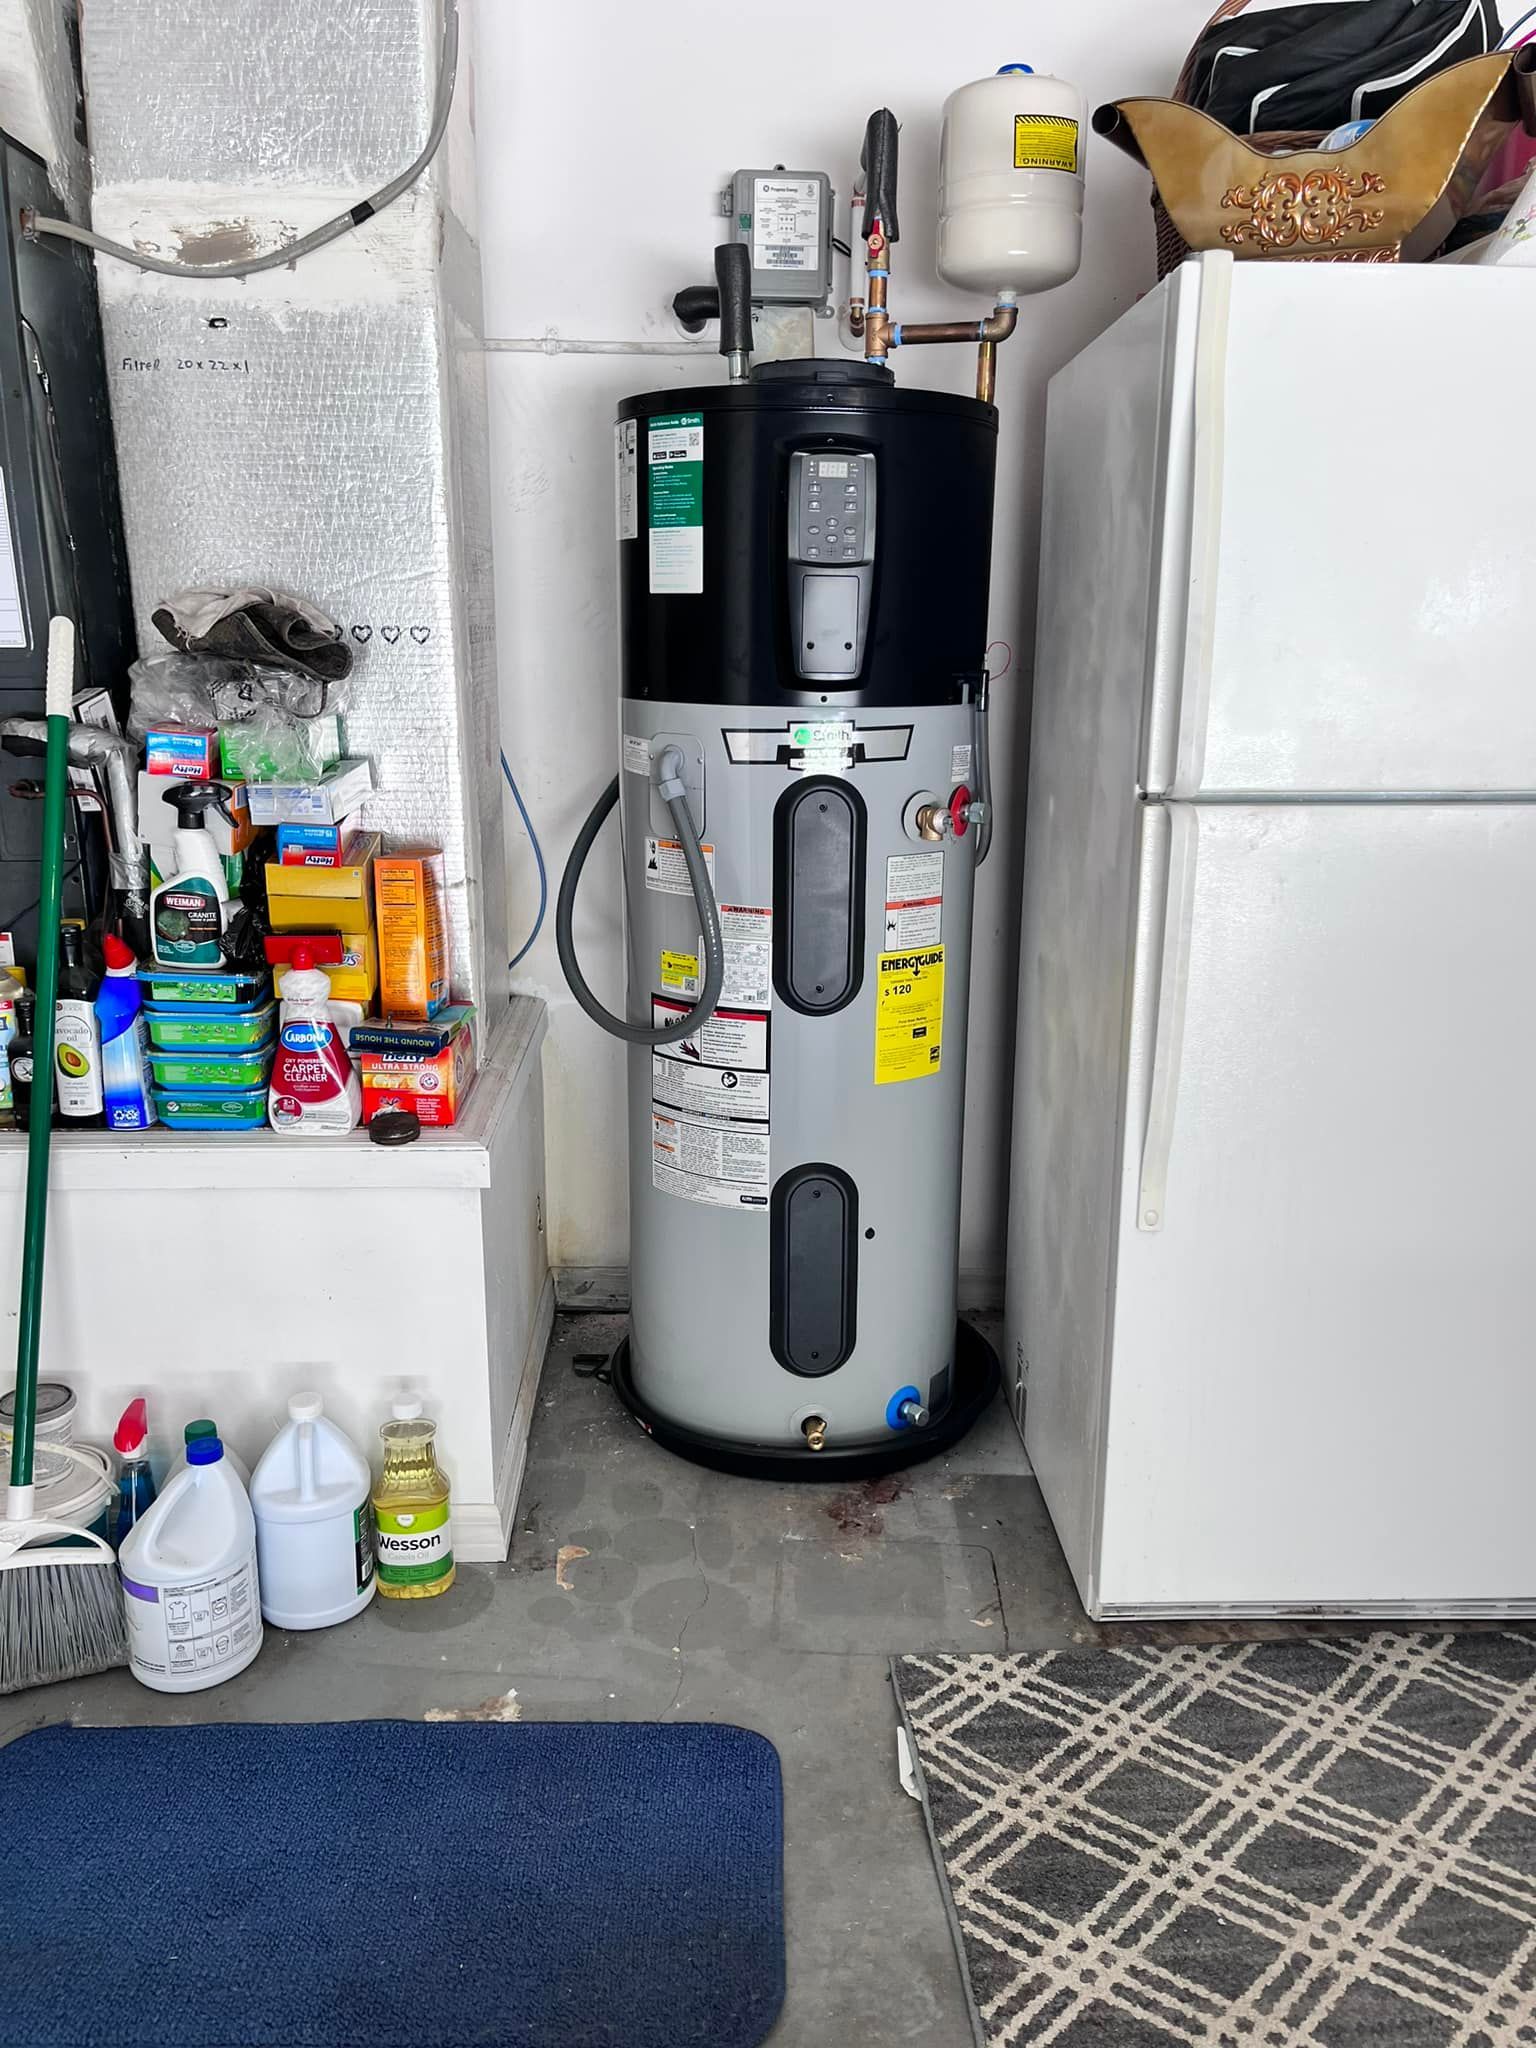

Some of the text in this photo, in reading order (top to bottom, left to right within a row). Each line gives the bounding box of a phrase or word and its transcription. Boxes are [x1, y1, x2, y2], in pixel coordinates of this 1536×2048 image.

[174, 765, 201, 774] Hefty
[306, 856, 333, 865] Hefty
[166, 896, 201, 907] WEIMAN
[732, 906, 765, 915] WARNING
[893, 984, 912, 995] 120
[355, 1033, 382, 1042] HOUSE
[401, 1038, 435, 1047] AROUND
[283, 1063, 328, 1073] CARPET
[402, 1063, 438, 1071] STRONG
[284, 1073, 328, 1082] CLEANER
[378, 1534, 440, 1551] Wesson
